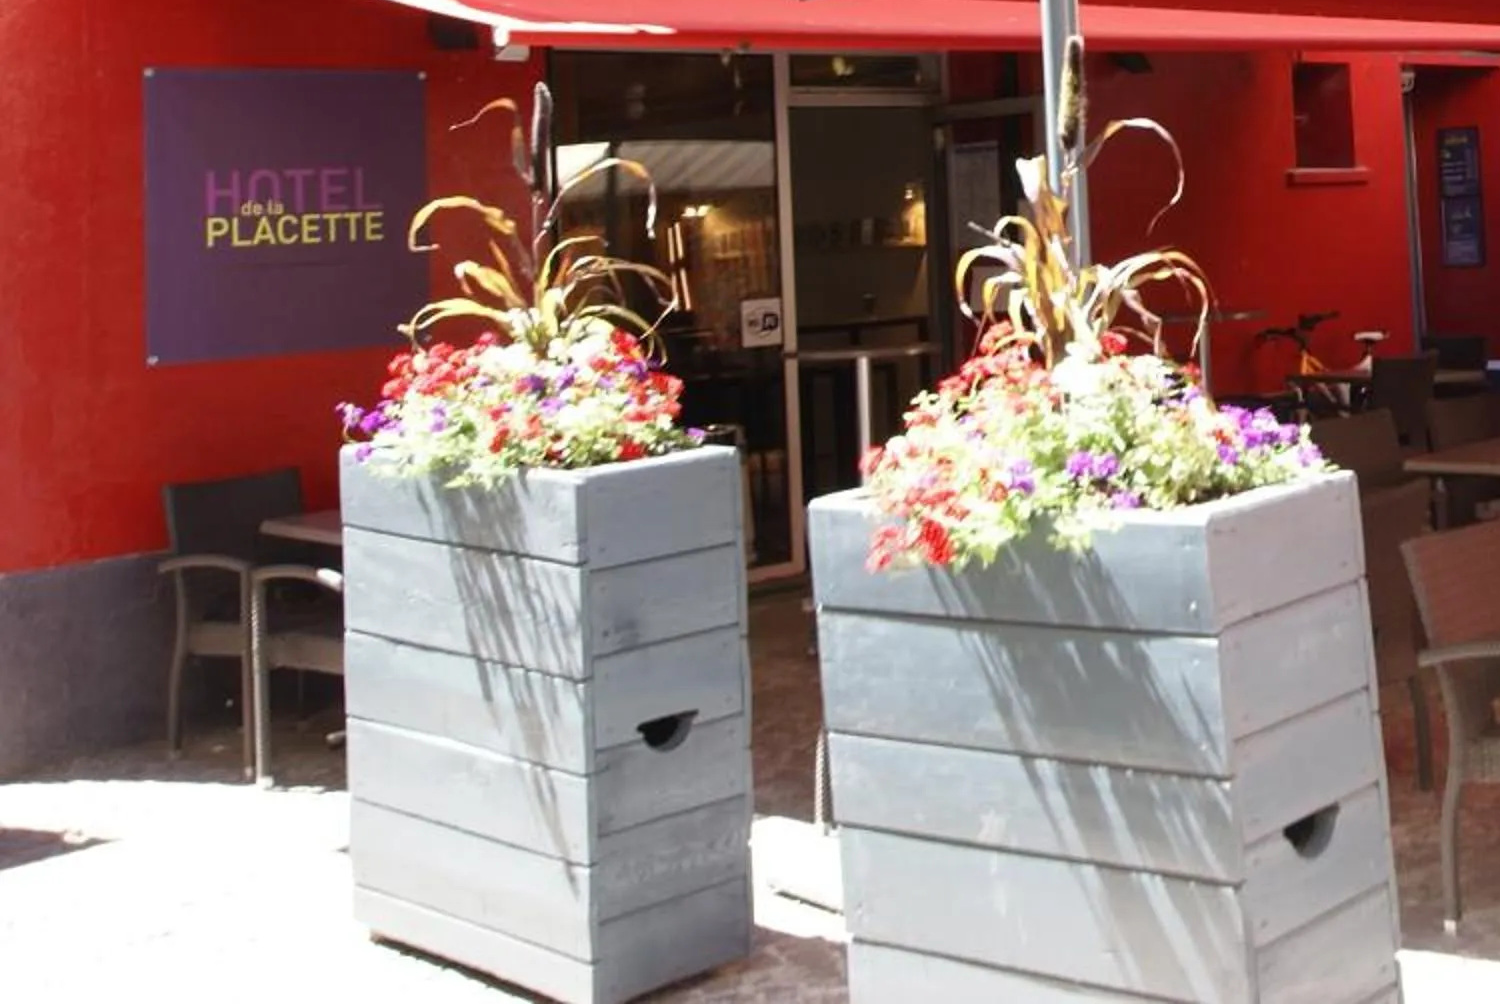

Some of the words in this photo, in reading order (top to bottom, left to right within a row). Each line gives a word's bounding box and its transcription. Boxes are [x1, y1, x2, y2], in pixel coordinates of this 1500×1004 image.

[204, 167, 384, 216] HOTEL
[241, 200, 263, 216] de
[267, 200, 284, 216] la
[206, 211, 384, 248] PLACETTE
